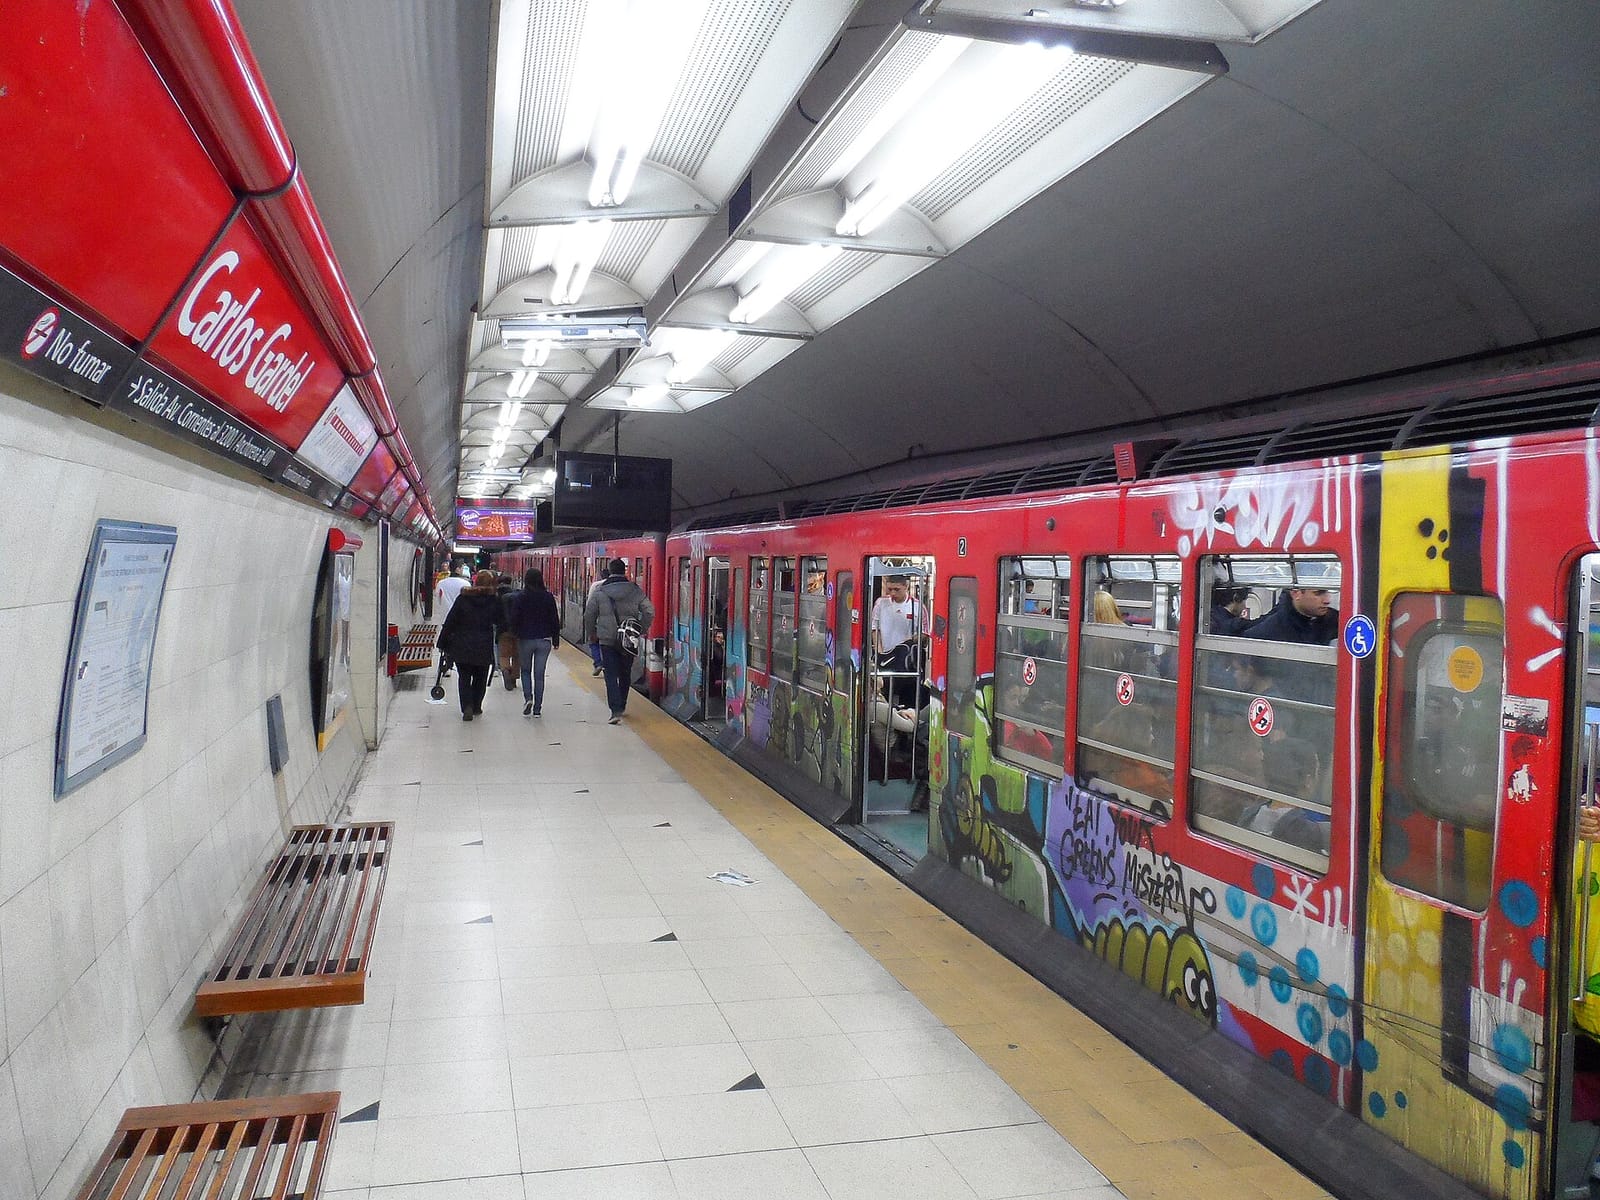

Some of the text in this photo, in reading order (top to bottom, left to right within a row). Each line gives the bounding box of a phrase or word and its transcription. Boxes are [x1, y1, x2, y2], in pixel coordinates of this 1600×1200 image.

[45, 328, 112, 384] No fumar
[178, 251, 315, 413] Carlos Gardel
[134, 378, 170, 416] Salida
[162, 394, 182, 422] Av.
[177, 402, 217, 439] Corrientes
[959, 540, 966, 555] 2
